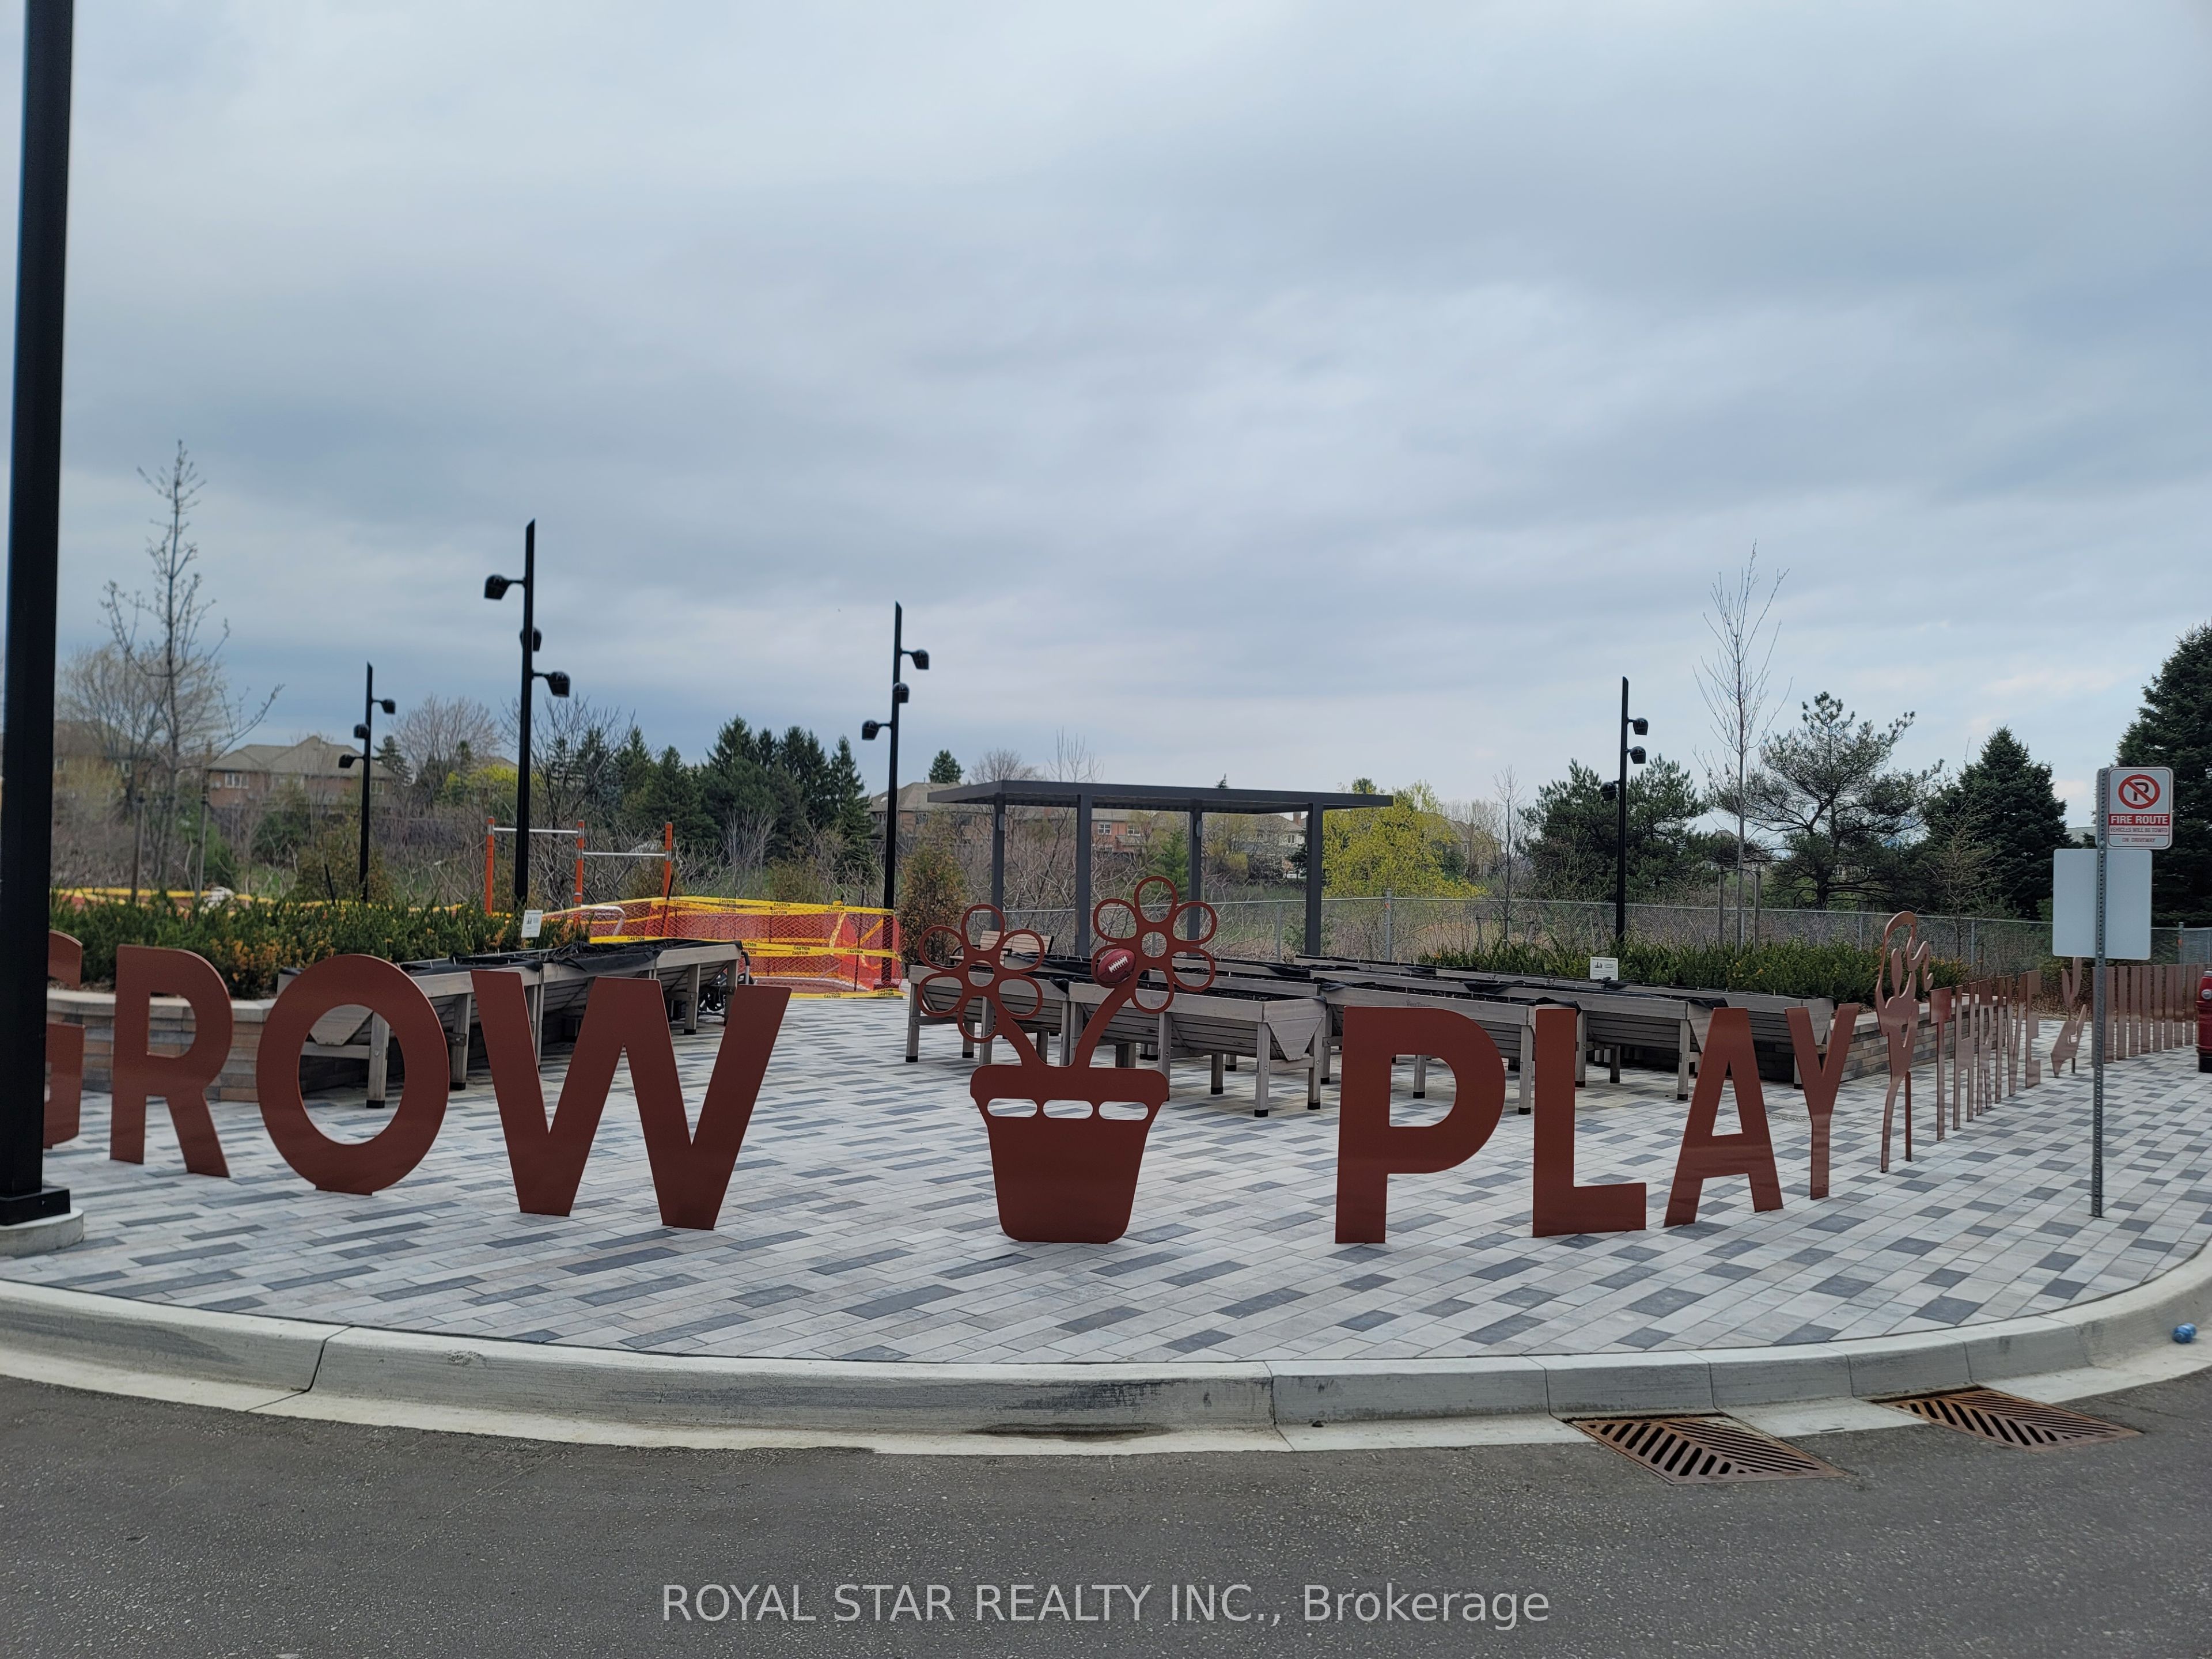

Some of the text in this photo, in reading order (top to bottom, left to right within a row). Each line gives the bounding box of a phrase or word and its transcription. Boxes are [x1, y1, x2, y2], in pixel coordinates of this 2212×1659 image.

[2111, 815, 2168, 824] FIRE ROUTE
[1335, 1003, 1859, 1244] PLAY
[1930, 969, 2041, 1141] THRIVE
